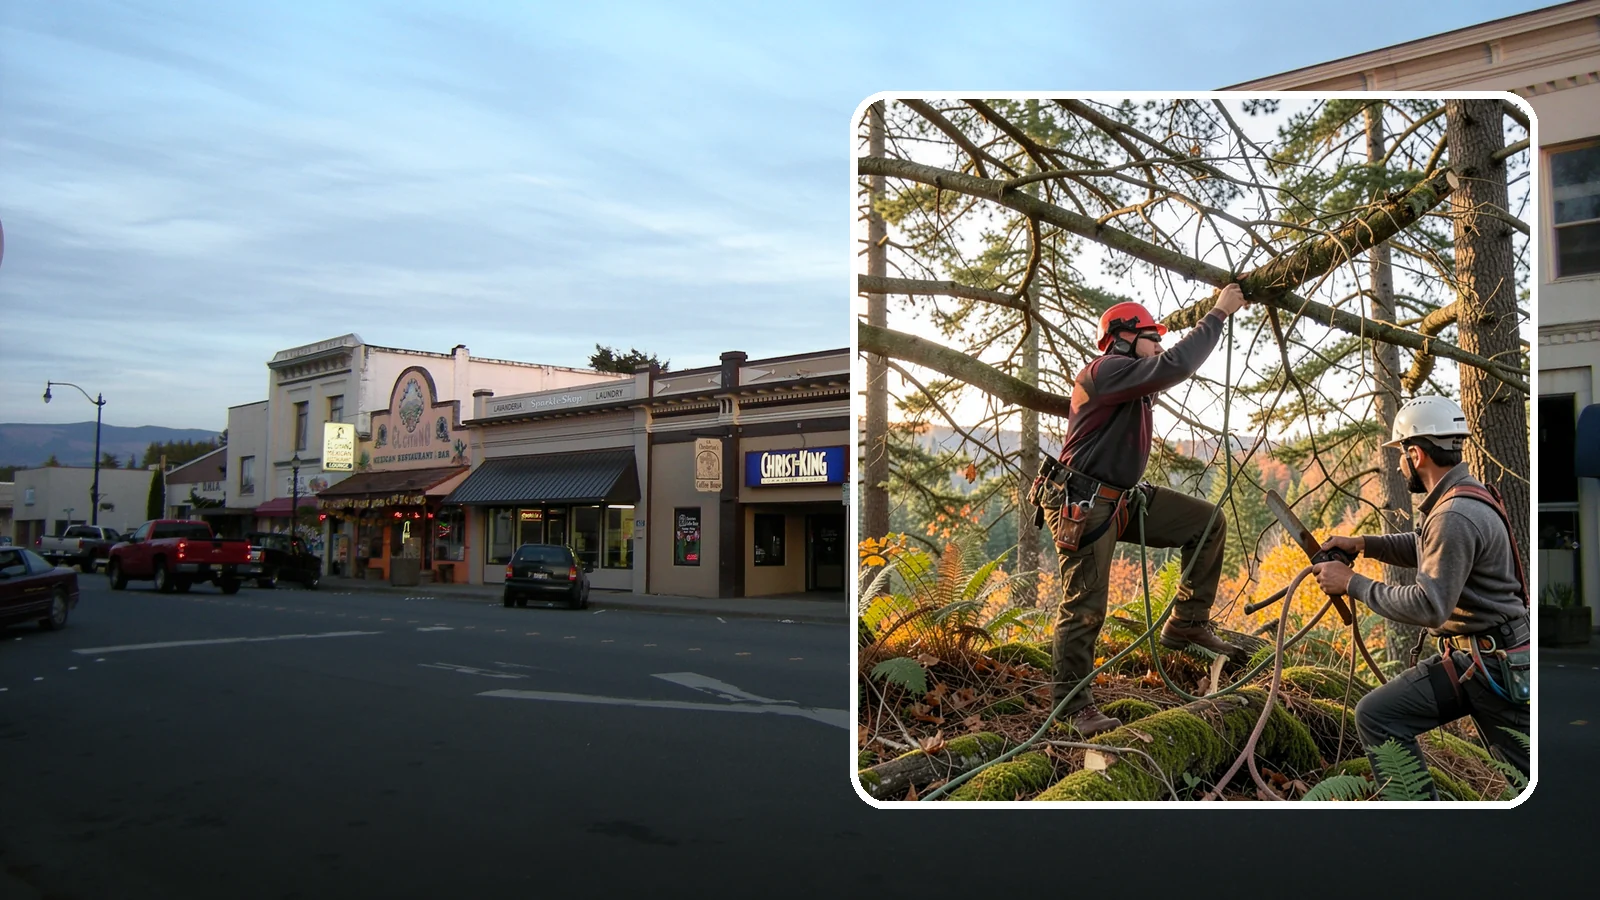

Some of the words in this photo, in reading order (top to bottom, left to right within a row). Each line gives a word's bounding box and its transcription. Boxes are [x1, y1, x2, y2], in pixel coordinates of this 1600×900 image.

[561, 394, 582, 406] Shop
[595, 389, 624, 400] LAUNDRY
[493, 402, 522, 412] LAVANDERIA
[373, 454, 396, 464] MEXICAN
[397, 451, 433, 462] RESTAURANT
[437, 450, 450, 459] BAR
[761, 452, 798, 478] CHRIST
[799, 450, 827, 476] KING
